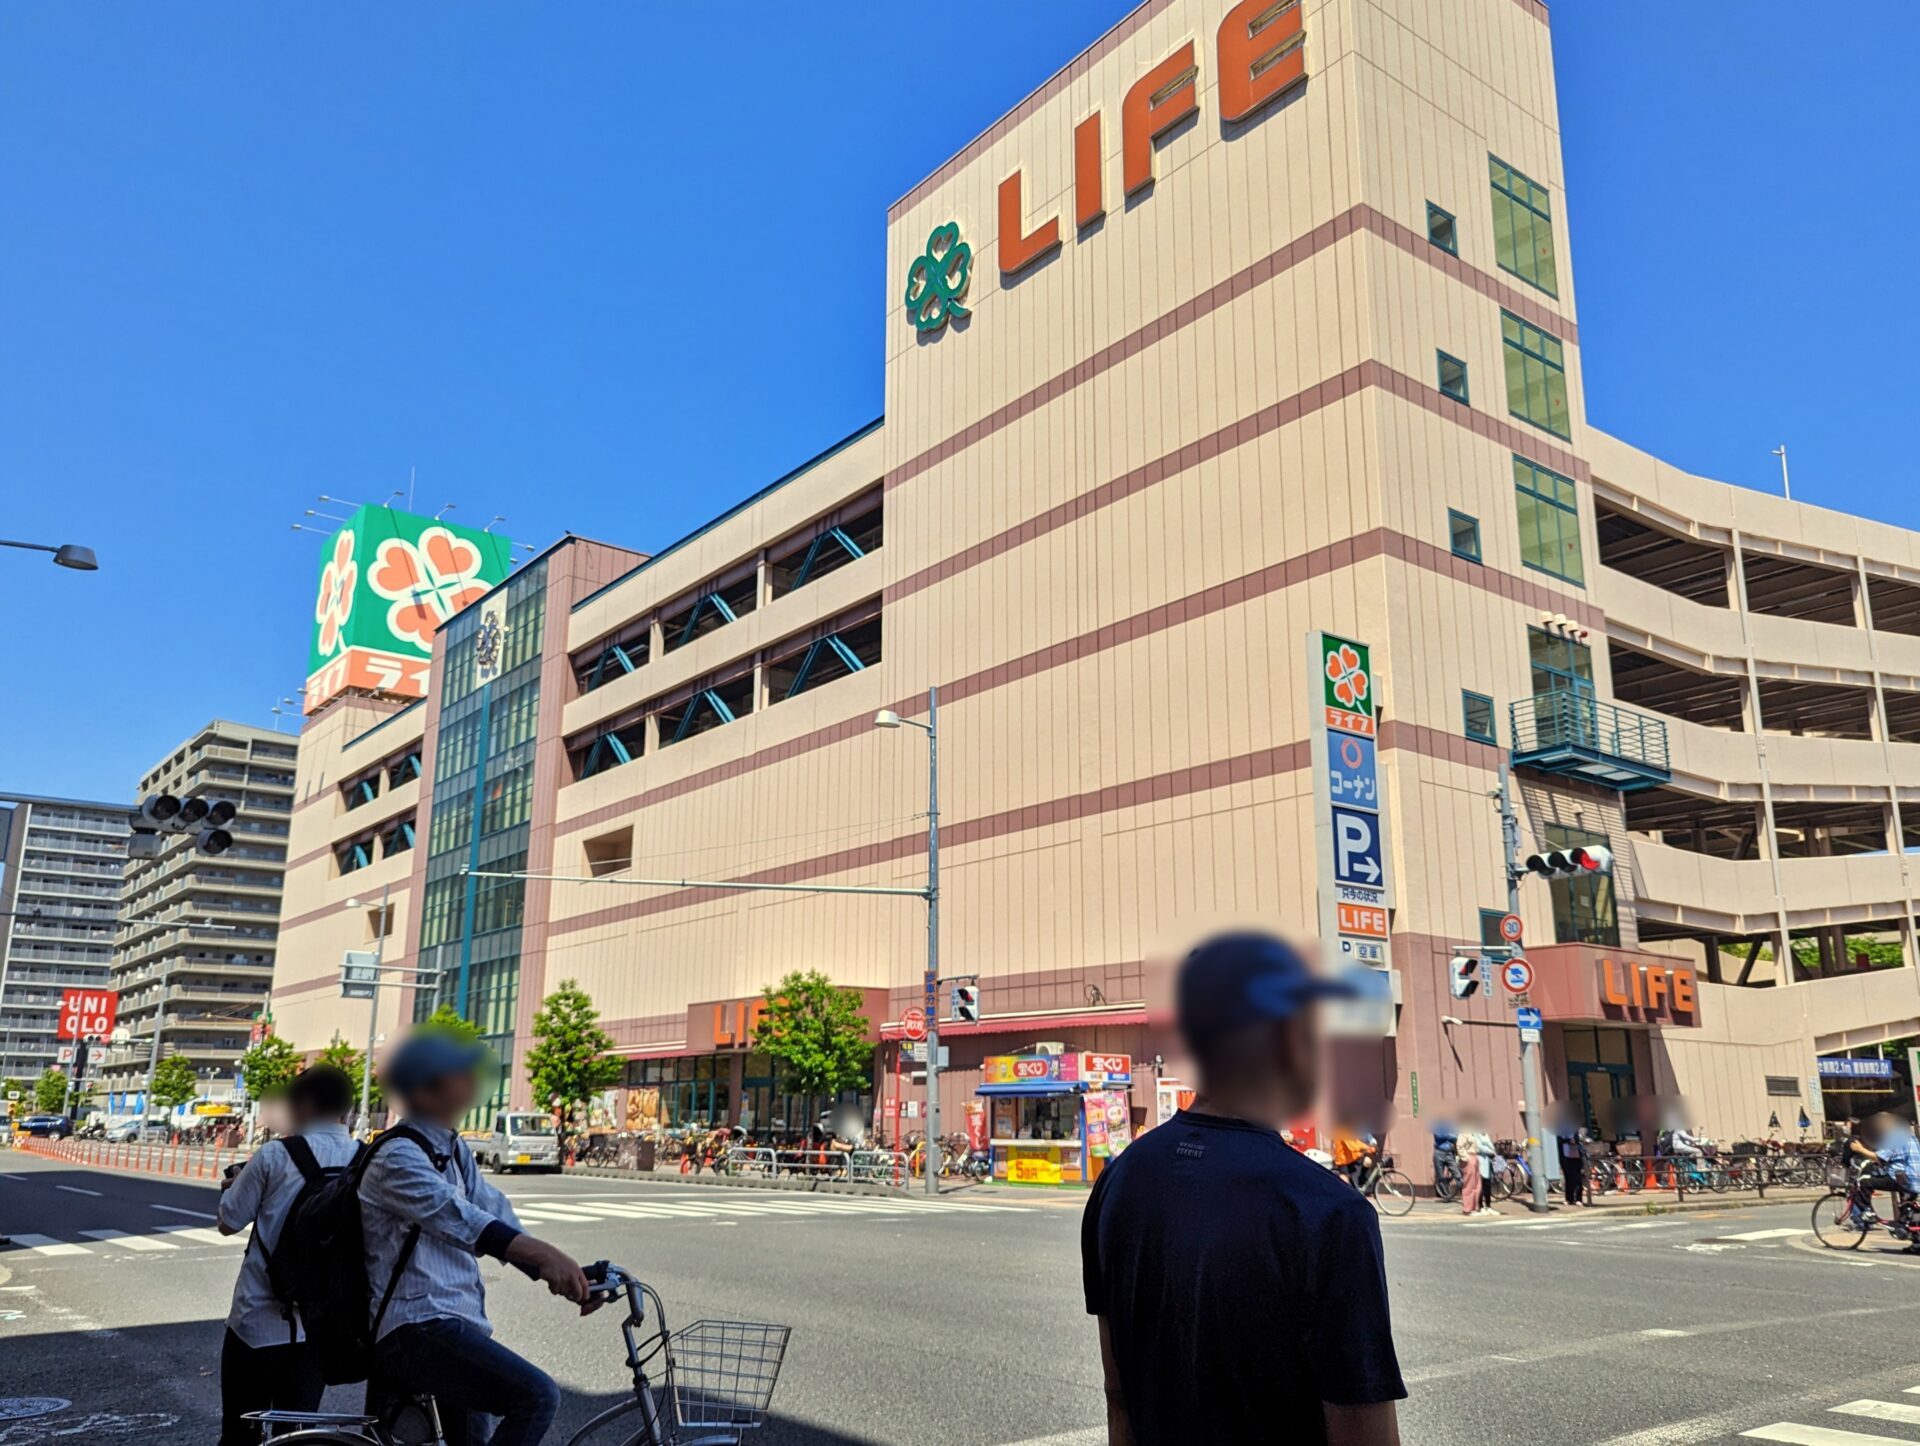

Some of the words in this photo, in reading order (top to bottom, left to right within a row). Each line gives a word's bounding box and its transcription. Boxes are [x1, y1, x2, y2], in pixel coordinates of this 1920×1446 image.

[999, 0, 1308, 274] LIFE
[1330, 709, 1369, 731] ライフ
[1330, 769, 1375, 800] コーナン
[1336, 813, 1371, 877] P
[1342, 887, 1379, 903] 只今の状況
[1340, 908, 1384, 932] LIFE
[1505, 921, 1518, 934] 30
[1602, 959, 1695, 1012] LIFE
[69, 995, 107, 1014] UNI
[66, 1015, 108, 1035] QLO
[63, 1049, 73, 1061] P
[1092, 1056, 1123, 1072] 宝くじ
[1017, 1062, 1044, 1076] 宝くじ
